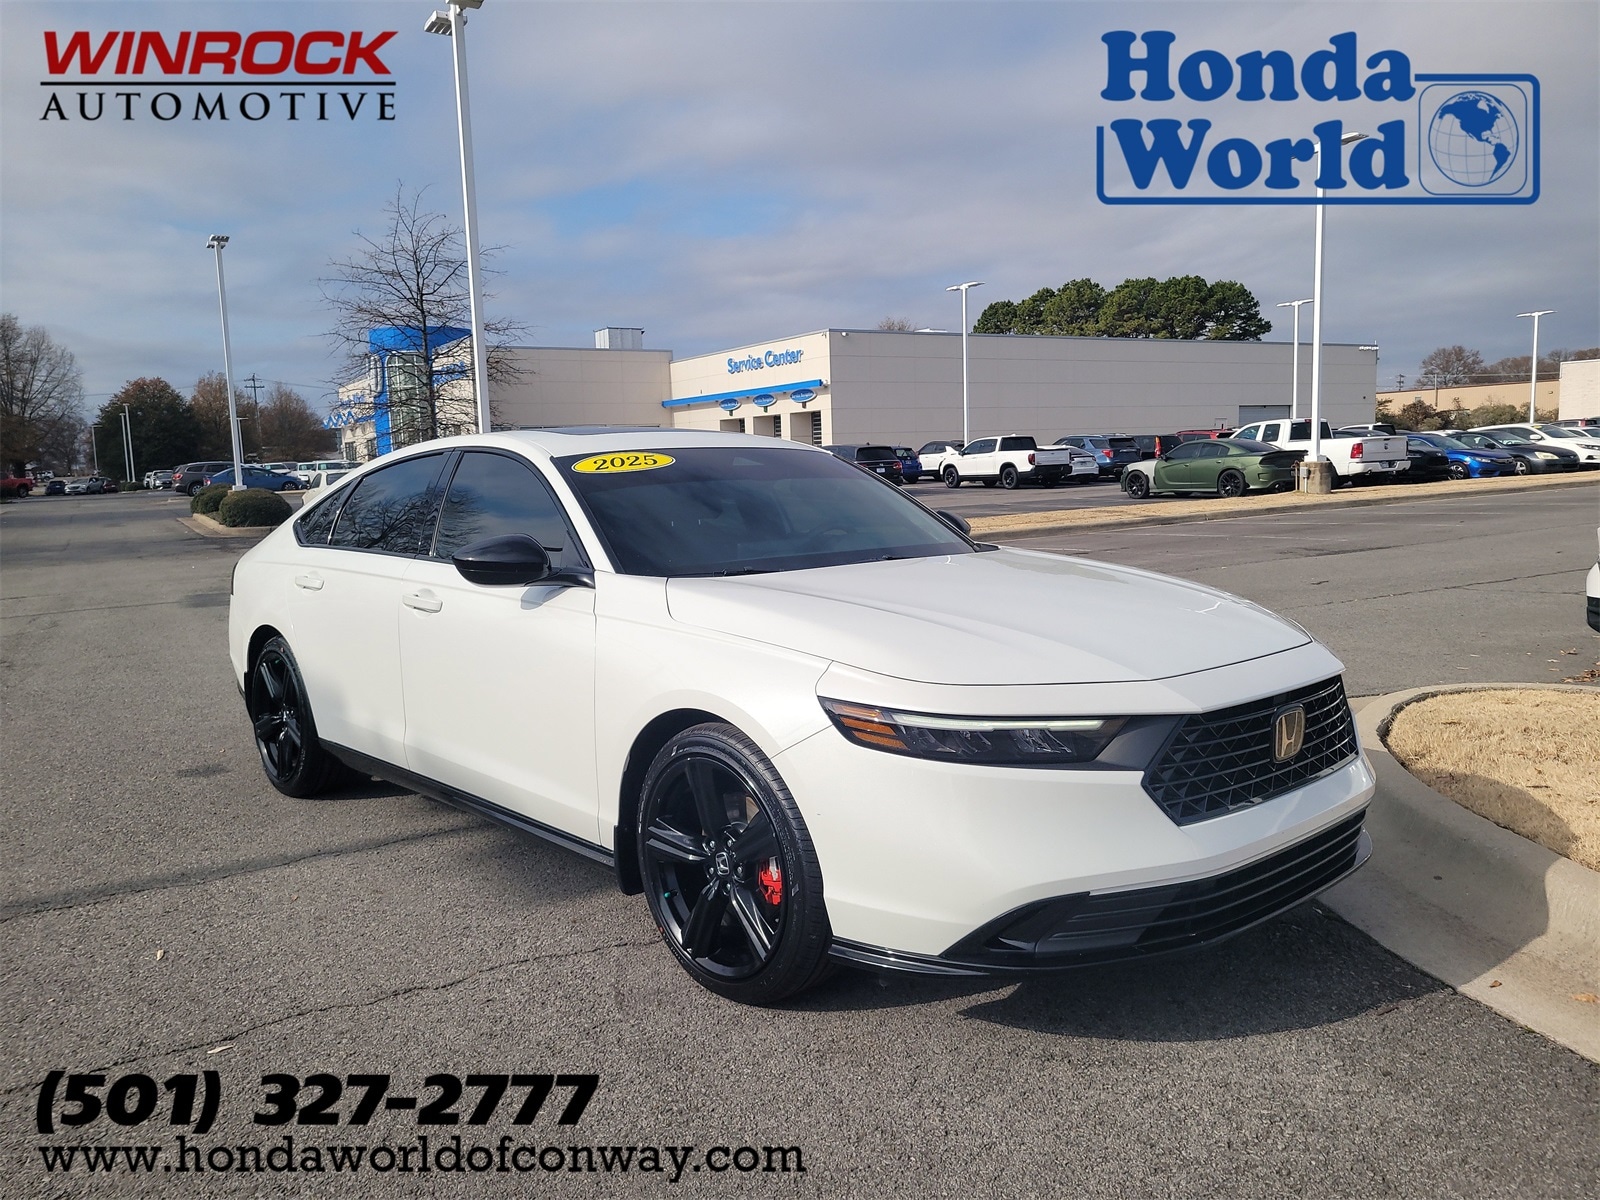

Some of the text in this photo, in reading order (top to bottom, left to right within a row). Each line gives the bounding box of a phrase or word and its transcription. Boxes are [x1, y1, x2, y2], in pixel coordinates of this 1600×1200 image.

[727, 349, 804, 375] Service Center
[593, 454, 658, 471] 2025
